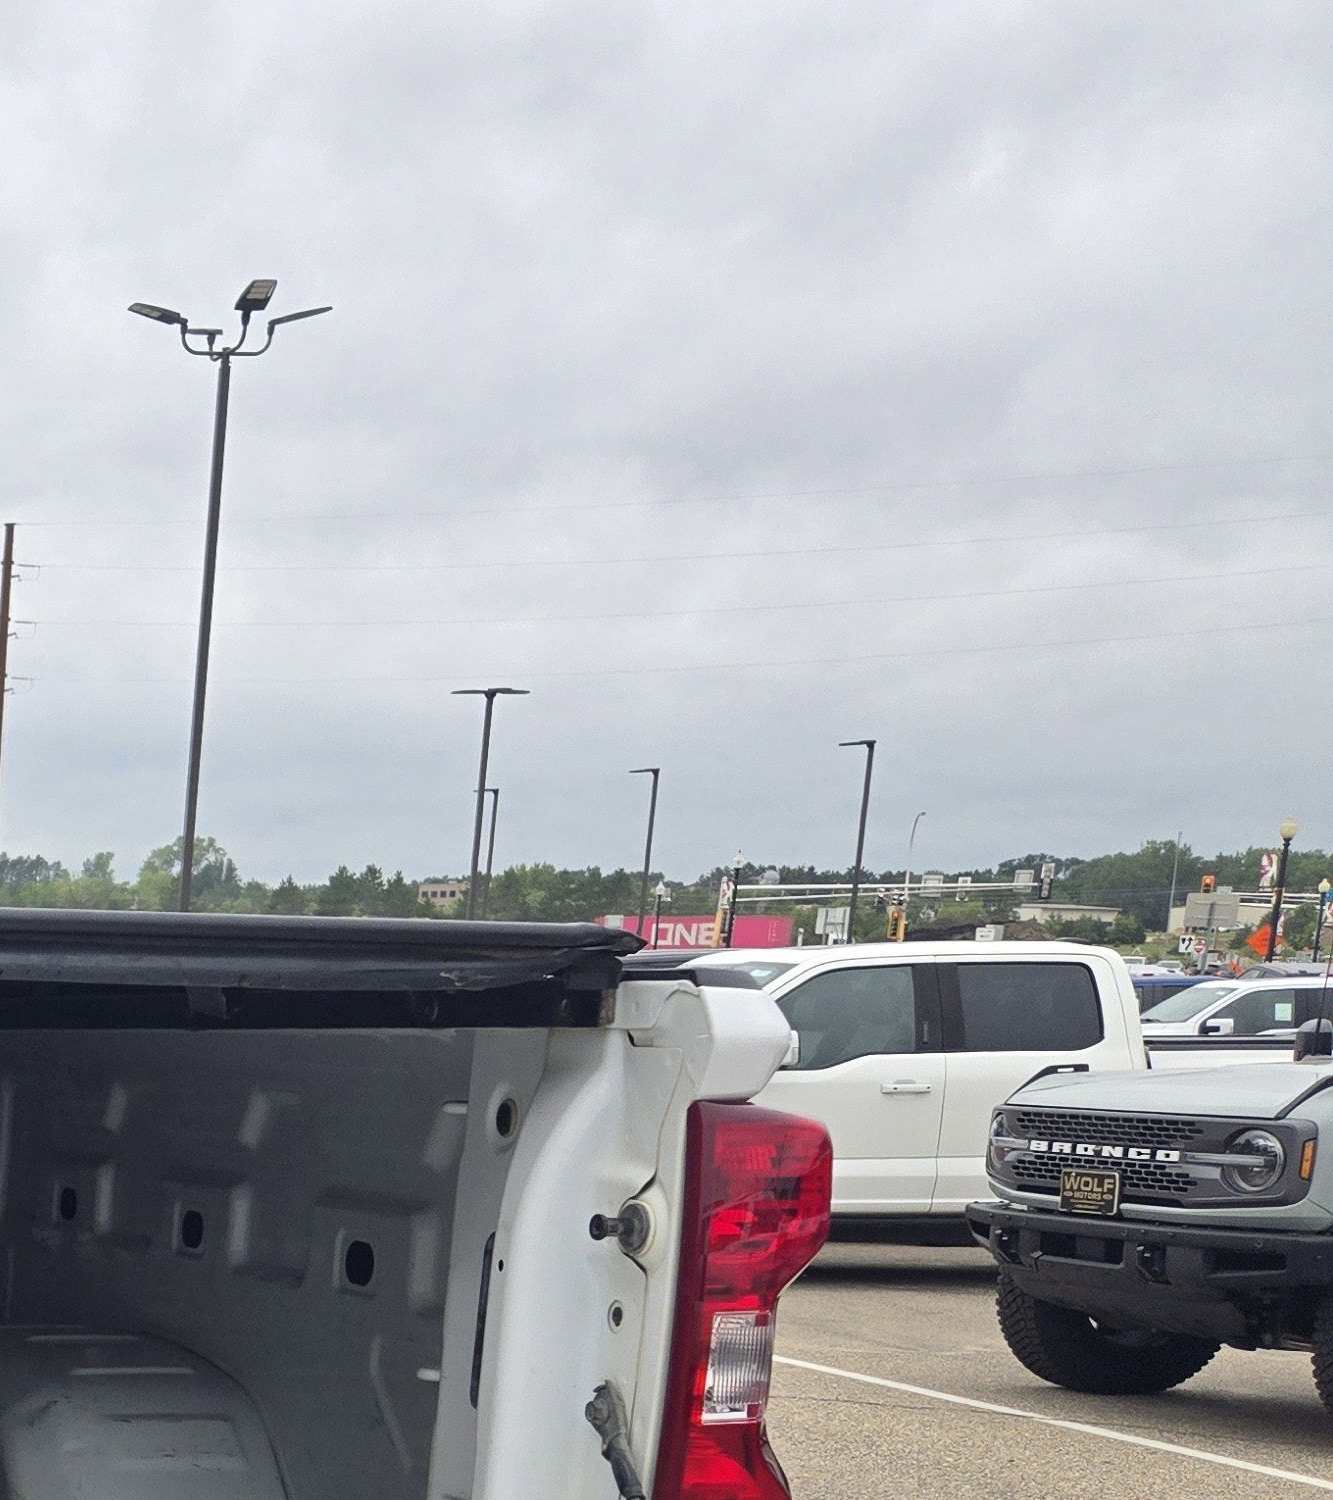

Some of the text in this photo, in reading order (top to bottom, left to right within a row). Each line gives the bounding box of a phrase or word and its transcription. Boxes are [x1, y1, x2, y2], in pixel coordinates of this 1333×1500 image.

[1029, 1139, 1180, 1162] BRONCO
[1064, 1175, 1114, 1192] WOLF
[1073, 1191, 1102, 1200] MOTORS
